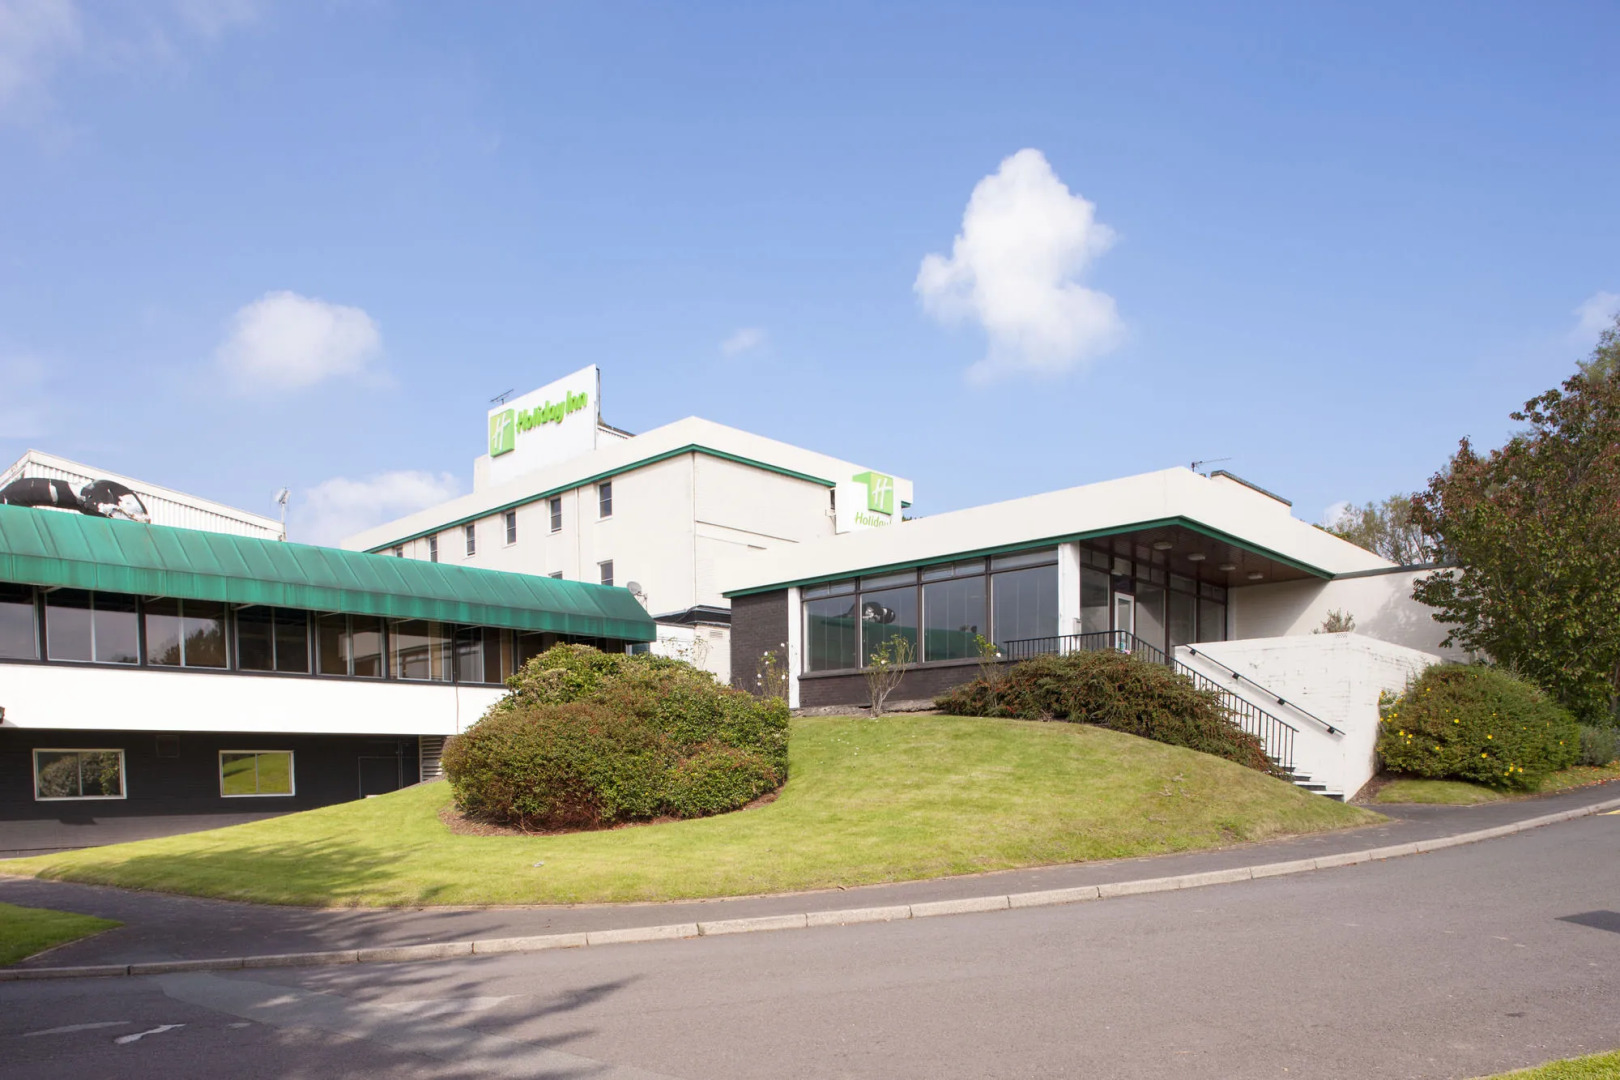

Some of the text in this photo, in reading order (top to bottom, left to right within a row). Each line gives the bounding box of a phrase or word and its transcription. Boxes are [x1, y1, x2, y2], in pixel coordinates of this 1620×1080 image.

[516, 390, 589, 435] Holiday Inn
[855, 511, 887, 527] Holida
